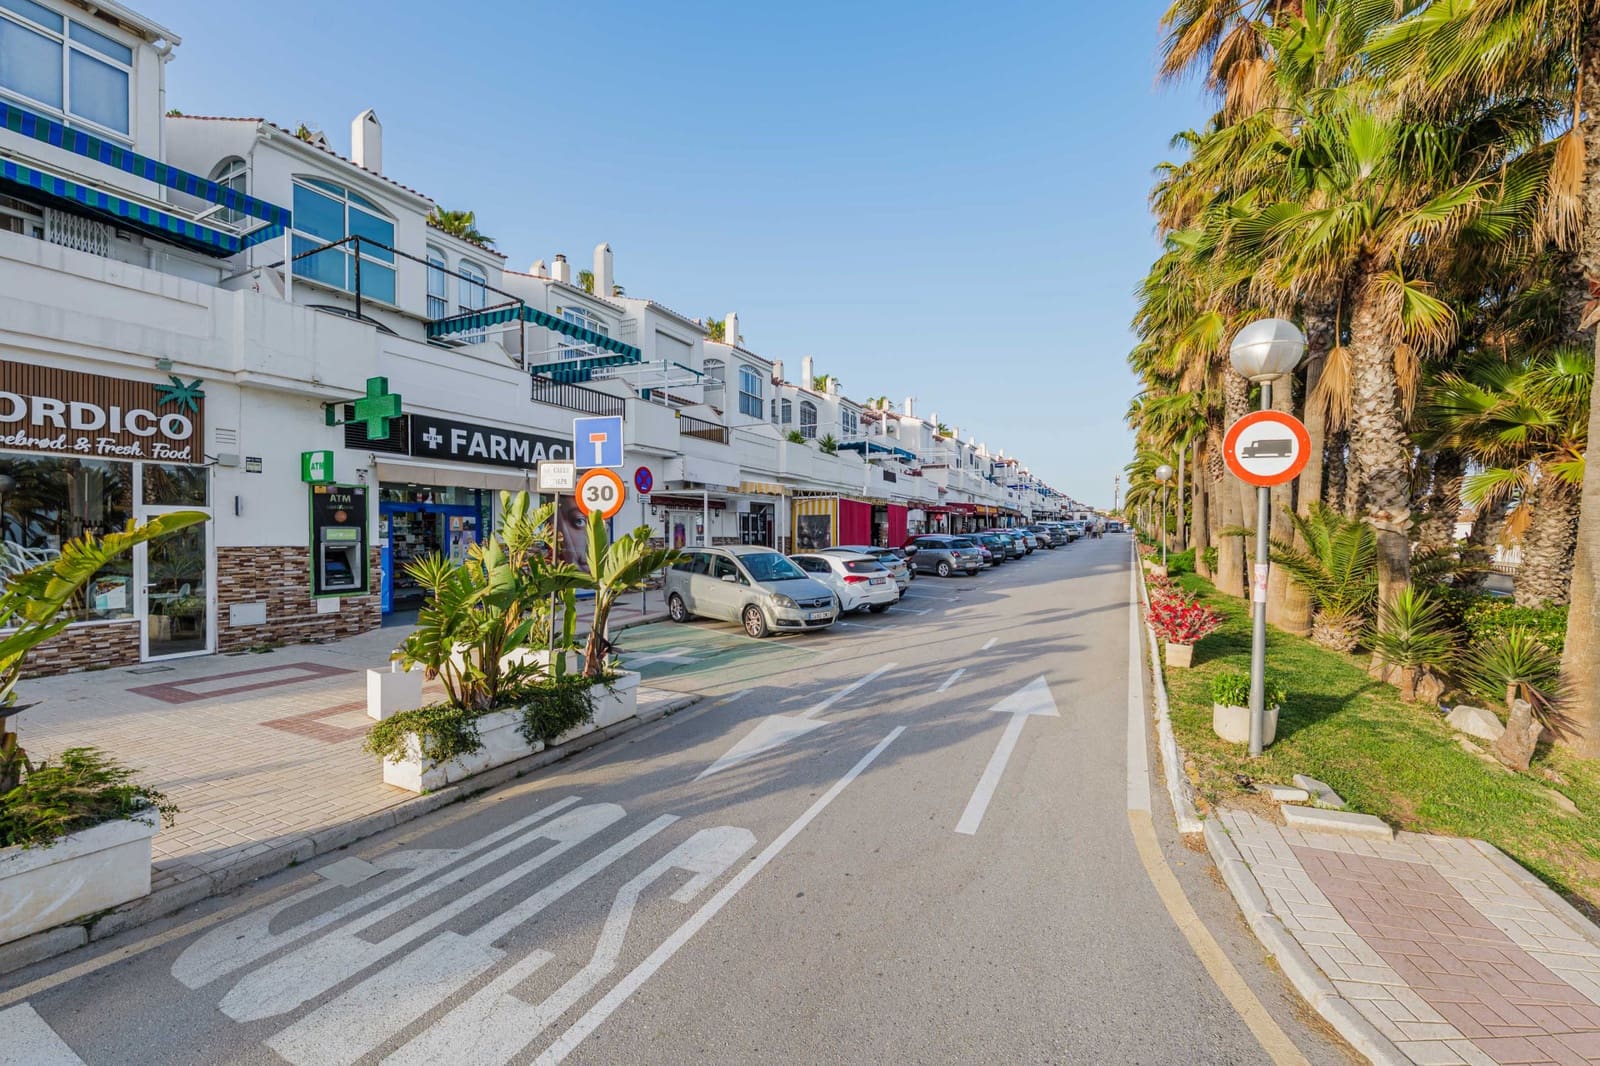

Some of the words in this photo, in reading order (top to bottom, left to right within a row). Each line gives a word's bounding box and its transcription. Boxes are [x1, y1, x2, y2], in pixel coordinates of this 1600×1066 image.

[74, 437, 91, 452] &
[96, 437, 143, 456] Fresh
[152, 442, 191, 460] Food
[451, 428, 571, 464] FARMACI
[330, 494, 351, 503] ATM
[587, 485, 613, 502] 30
